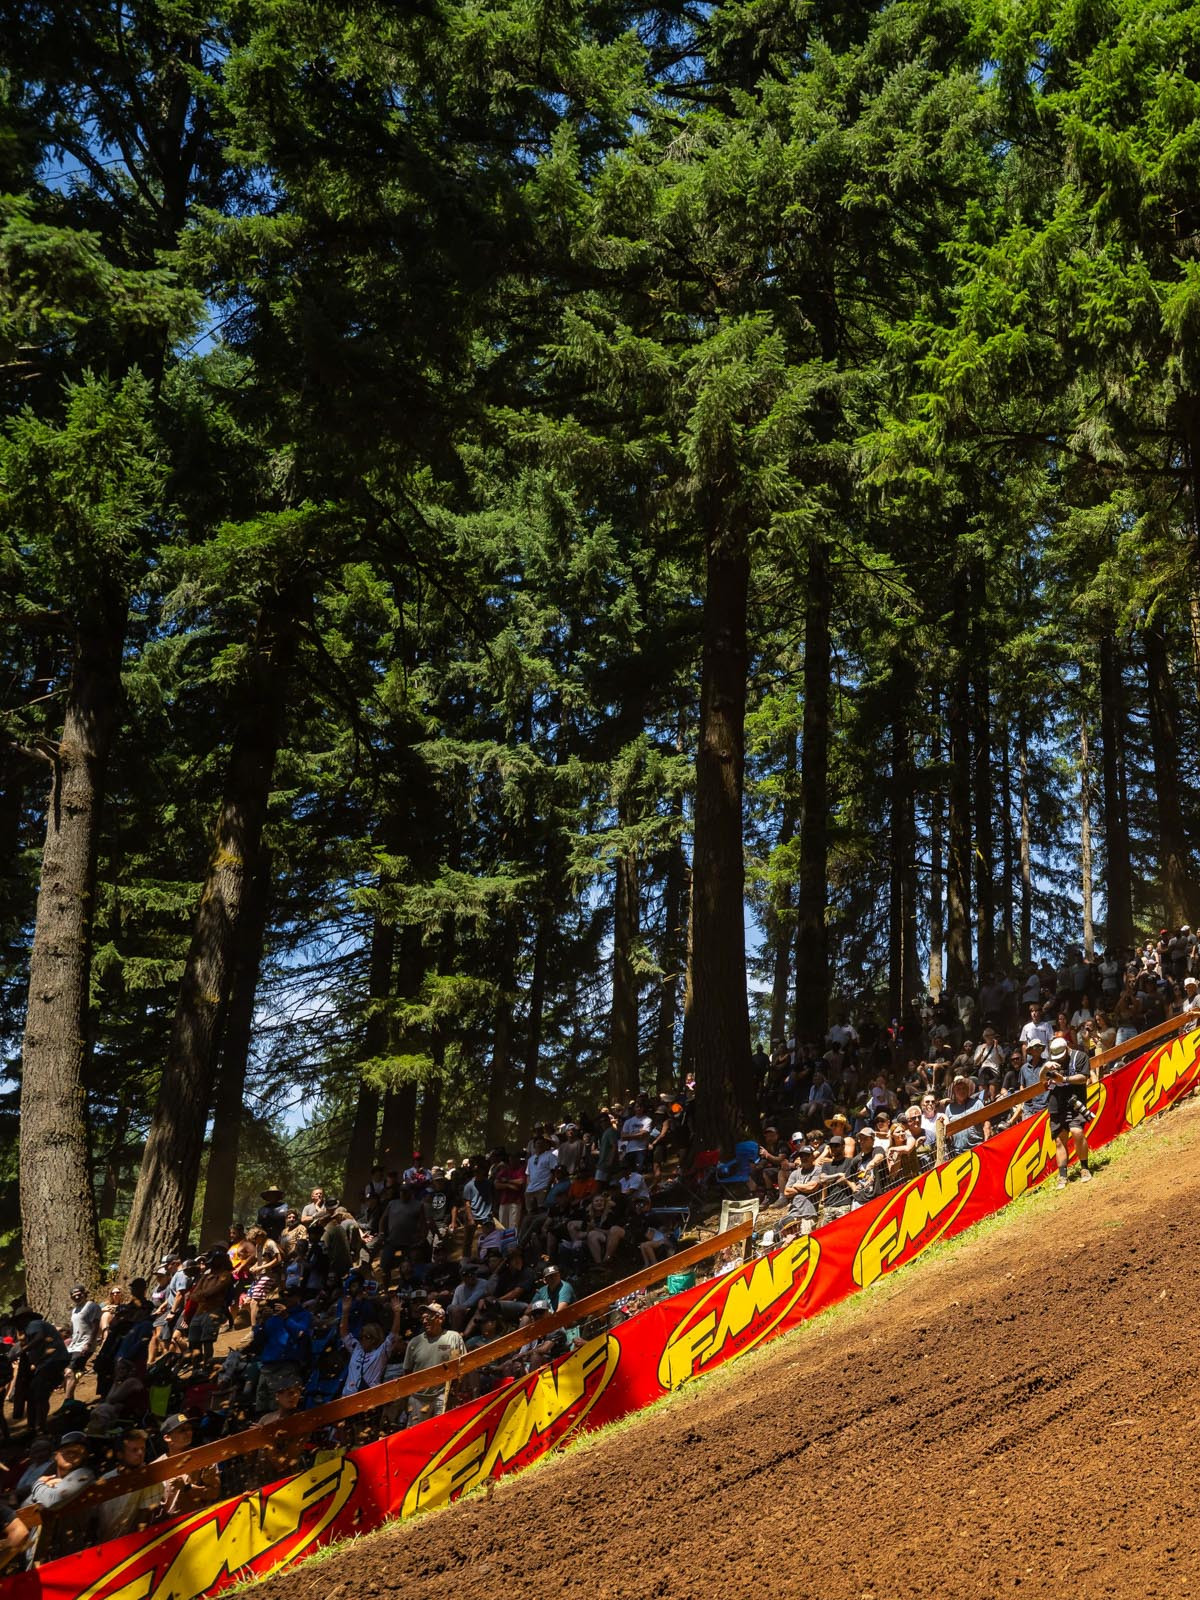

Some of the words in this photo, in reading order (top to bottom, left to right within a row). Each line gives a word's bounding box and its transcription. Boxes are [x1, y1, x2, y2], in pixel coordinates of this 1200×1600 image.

[859, 1149, 975, 1290] FMF
[666, 1234, 812, 1393] FMF
[416, 1331, 609, 1514] FMF
